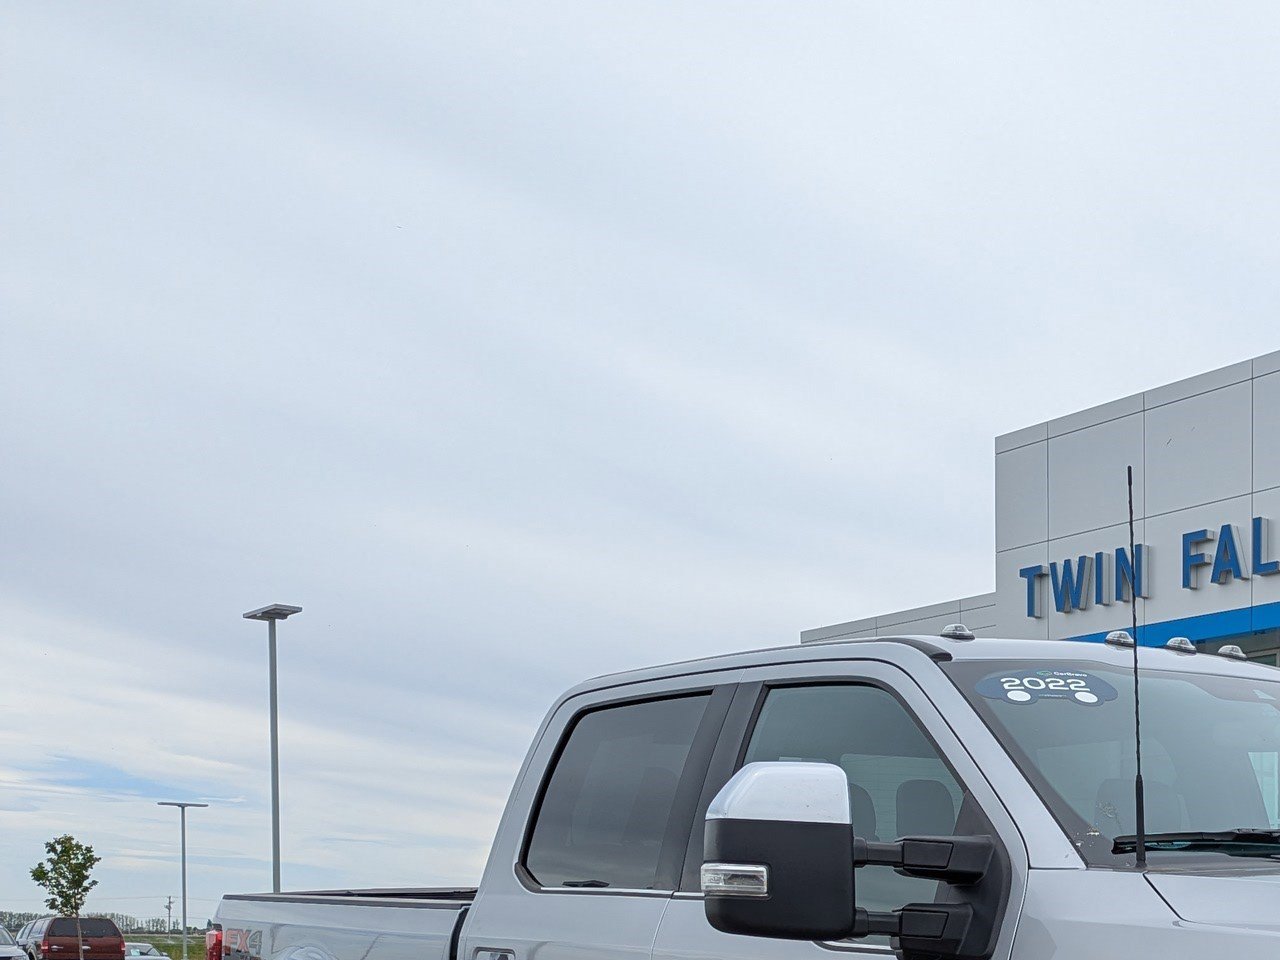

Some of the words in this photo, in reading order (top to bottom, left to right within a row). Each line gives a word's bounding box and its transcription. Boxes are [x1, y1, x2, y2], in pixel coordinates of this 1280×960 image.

[1019, 543, 1150, 619] TWIN
[1000, 677, 1091, 691] 2022
[223, 928, 263, 958] FX4
